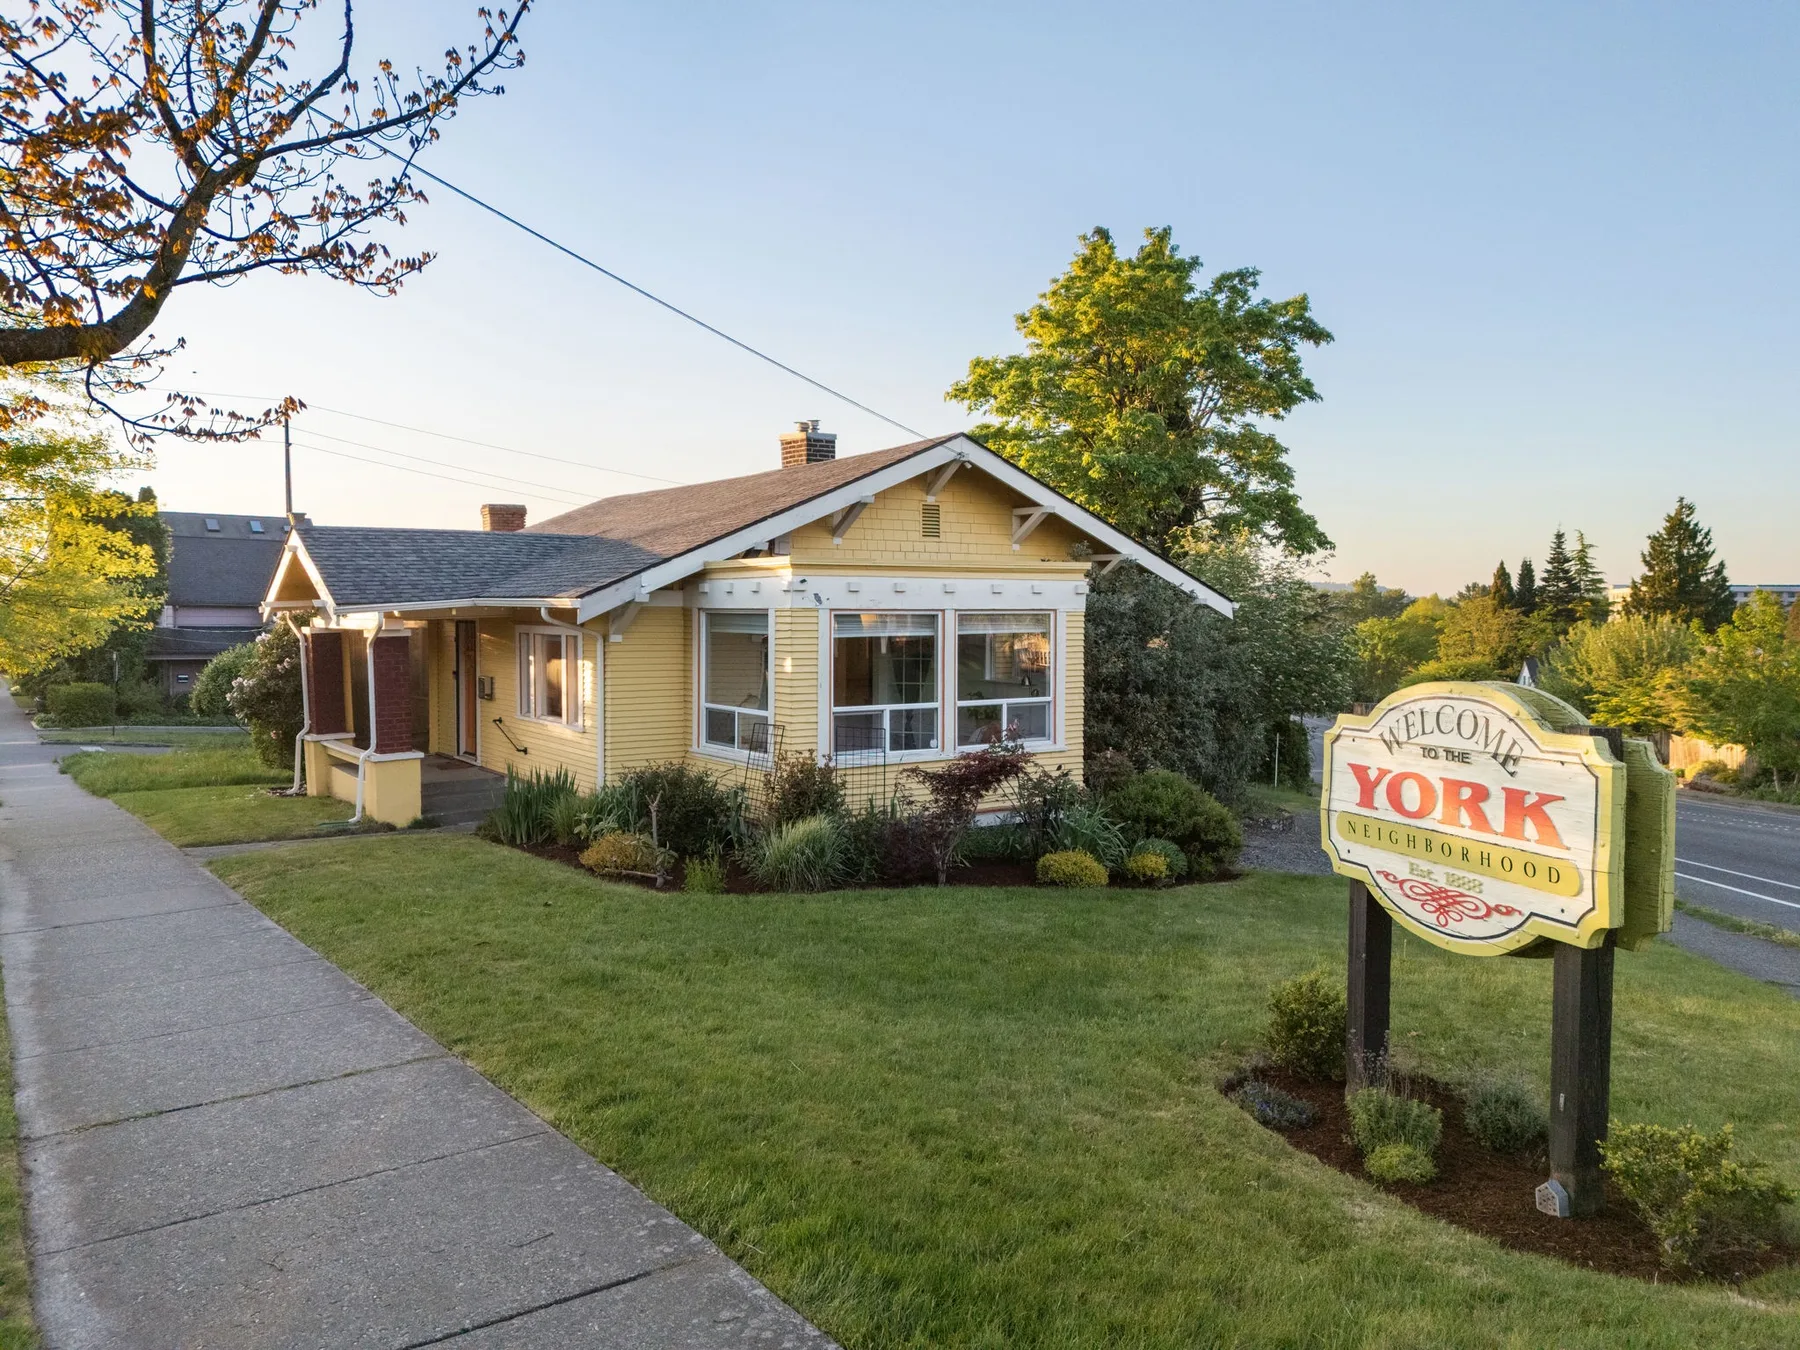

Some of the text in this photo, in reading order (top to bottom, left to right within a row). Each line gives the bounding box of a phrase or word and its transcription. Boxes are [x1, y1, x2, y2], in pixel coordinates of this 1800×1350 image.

[1378, 704, 1524, 778] WELCOME
[1420, 746, 1471, 765] TO THE
[1347, 762, 1570, 850] YORK
[1348, 820, 1560, 884] NEIGHBORHOOD
